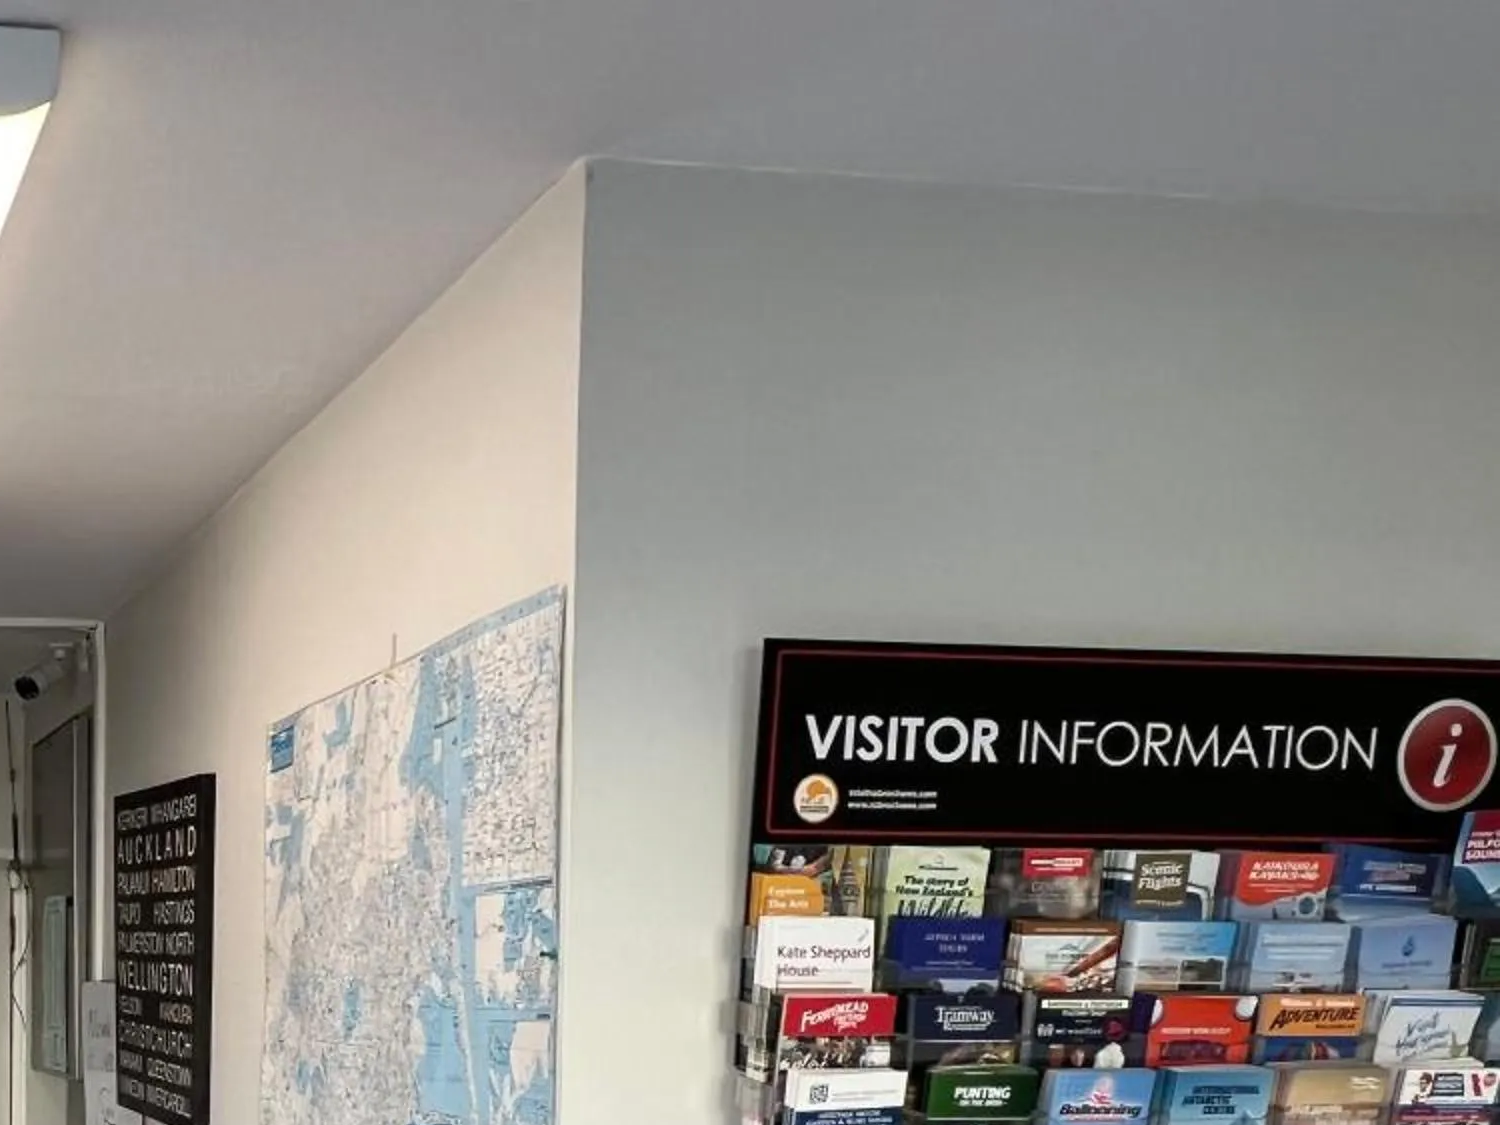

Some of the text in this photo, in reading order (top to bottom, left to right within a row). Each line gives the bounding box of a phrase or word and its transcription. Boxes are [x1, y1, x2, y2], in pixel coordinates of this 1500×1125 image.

[805, 714, 999, 763] VISITOR
[1017, 720, 1379, 770] INFORMATION
[117, 825, 197, 865] AUCKLAND
[1140, 863, 1183, 877] Scenic
[904, 875, 969, 887] The story of
[1138, 876, 1182, 891] Flights
[896, 885, 920, 896] New
[153, 899, 196, 925] HASTINGS
[777, 945, 871, 961] Kate Sheppard
[118, 959, 194, 997] WELLINGTON
[777, 965, 819, 977] House
[935, 1005, 996, 1023] Tramway
[1270, 1007, 1360, 1031] ADVENTURE
[954, 1086, 1011, 1099] PUNTING
[1060, 1104, 1143, 1118] Ballooning
